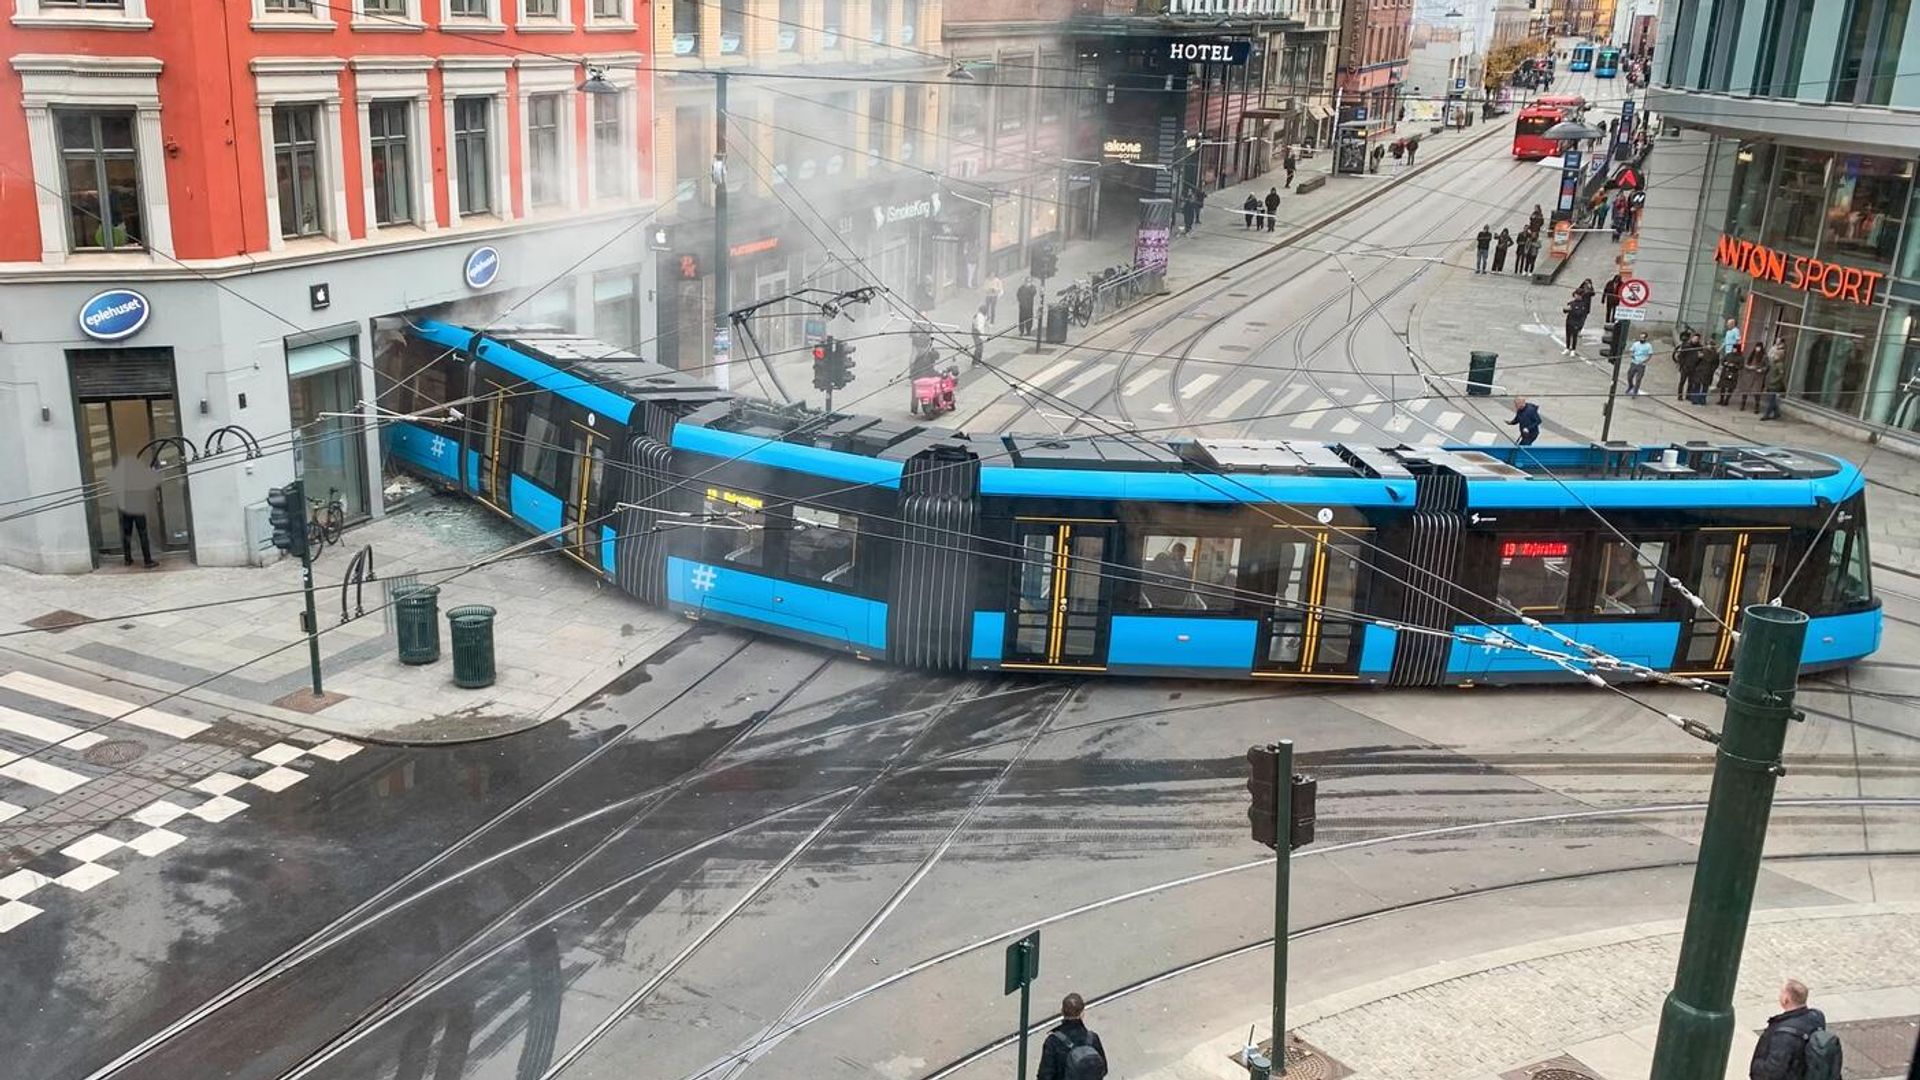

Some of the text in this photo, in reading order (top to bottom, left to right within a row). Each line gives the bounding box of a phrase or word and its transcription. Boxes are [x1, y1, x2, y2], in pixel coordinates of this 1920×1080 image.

[1170, 43, 1233, 61] HOTEL
[1714, 233, 1883, 305] ANTON SPORT
[86, 298, 142, 326] eplehuset
[1504, 542, 1516, 556] 19
